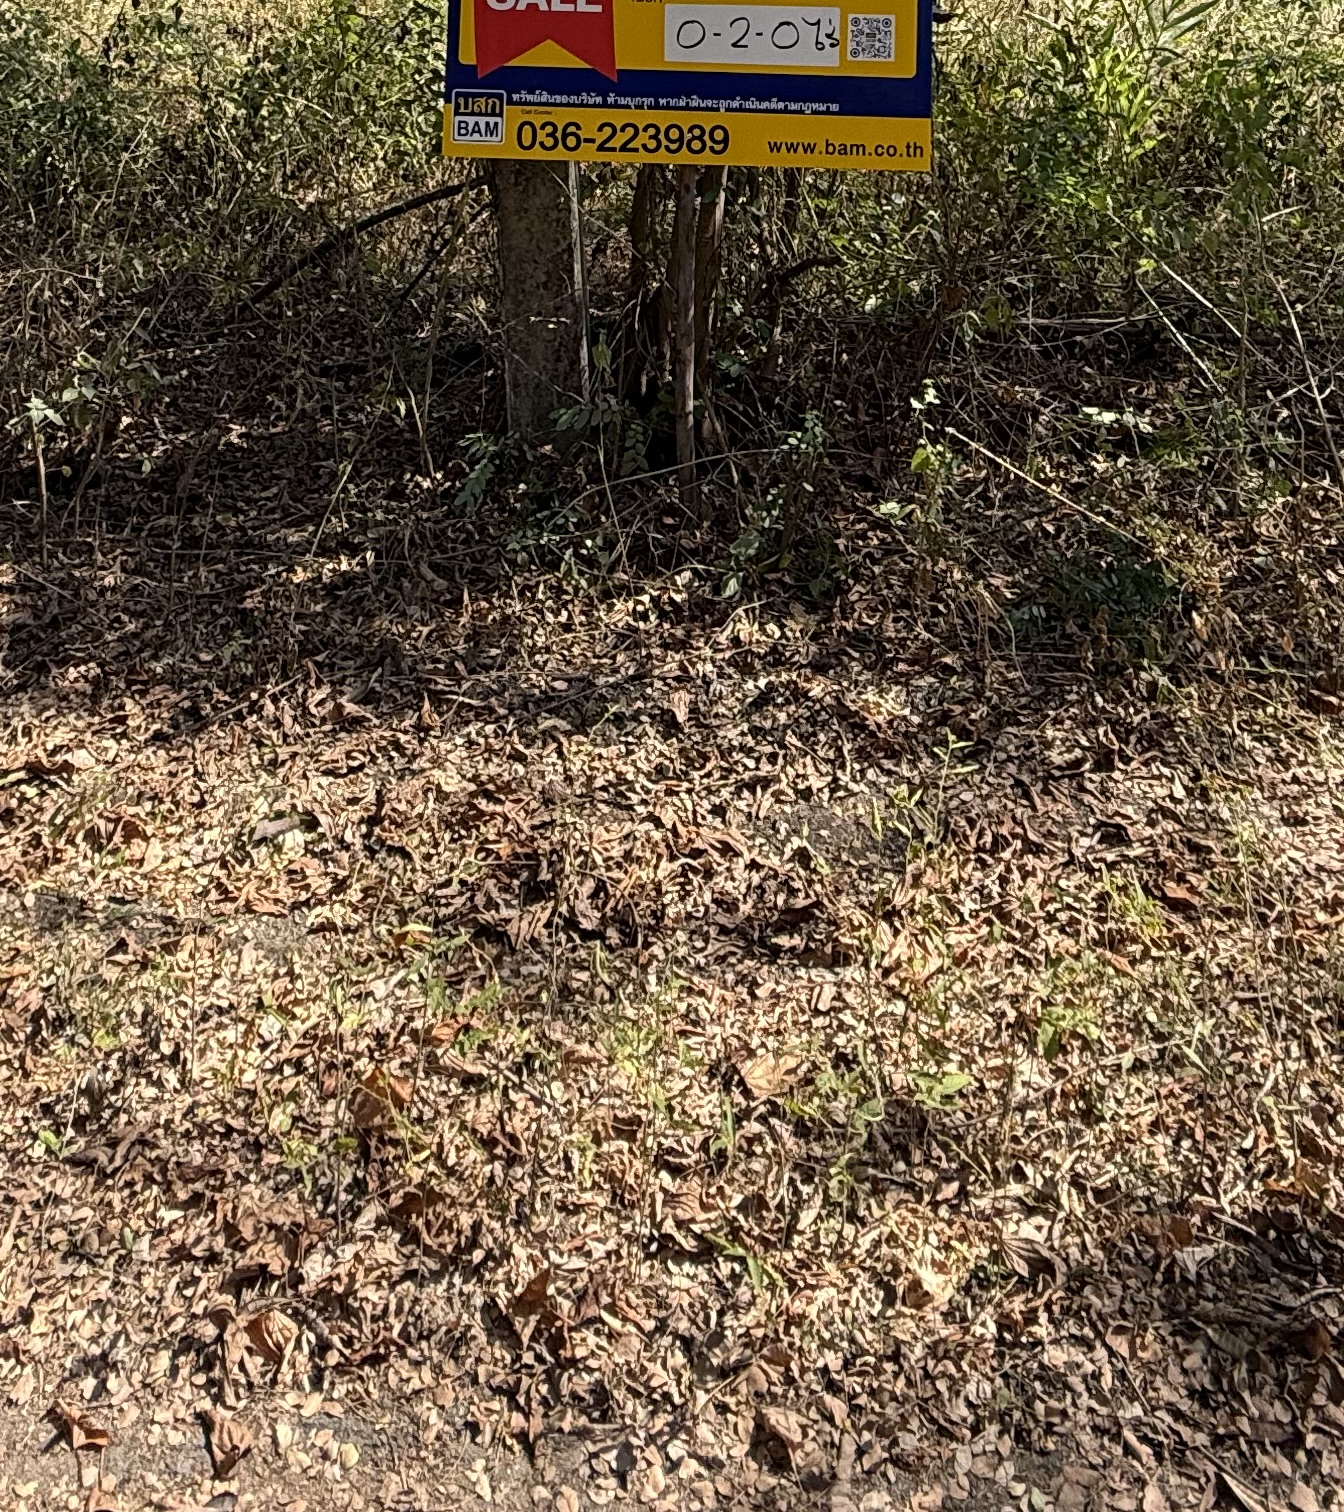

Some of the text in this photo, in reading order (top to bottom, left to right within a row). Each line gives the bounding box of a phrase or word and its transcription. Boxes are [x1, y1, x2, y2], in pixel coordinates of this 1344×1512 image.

[457, 96, 500, 114] บสก
[457, 120, 499, 138] BAM
[516, 120, 730, 156] 036-223989
[767, 138, 925, 158] www.bam.co.th
